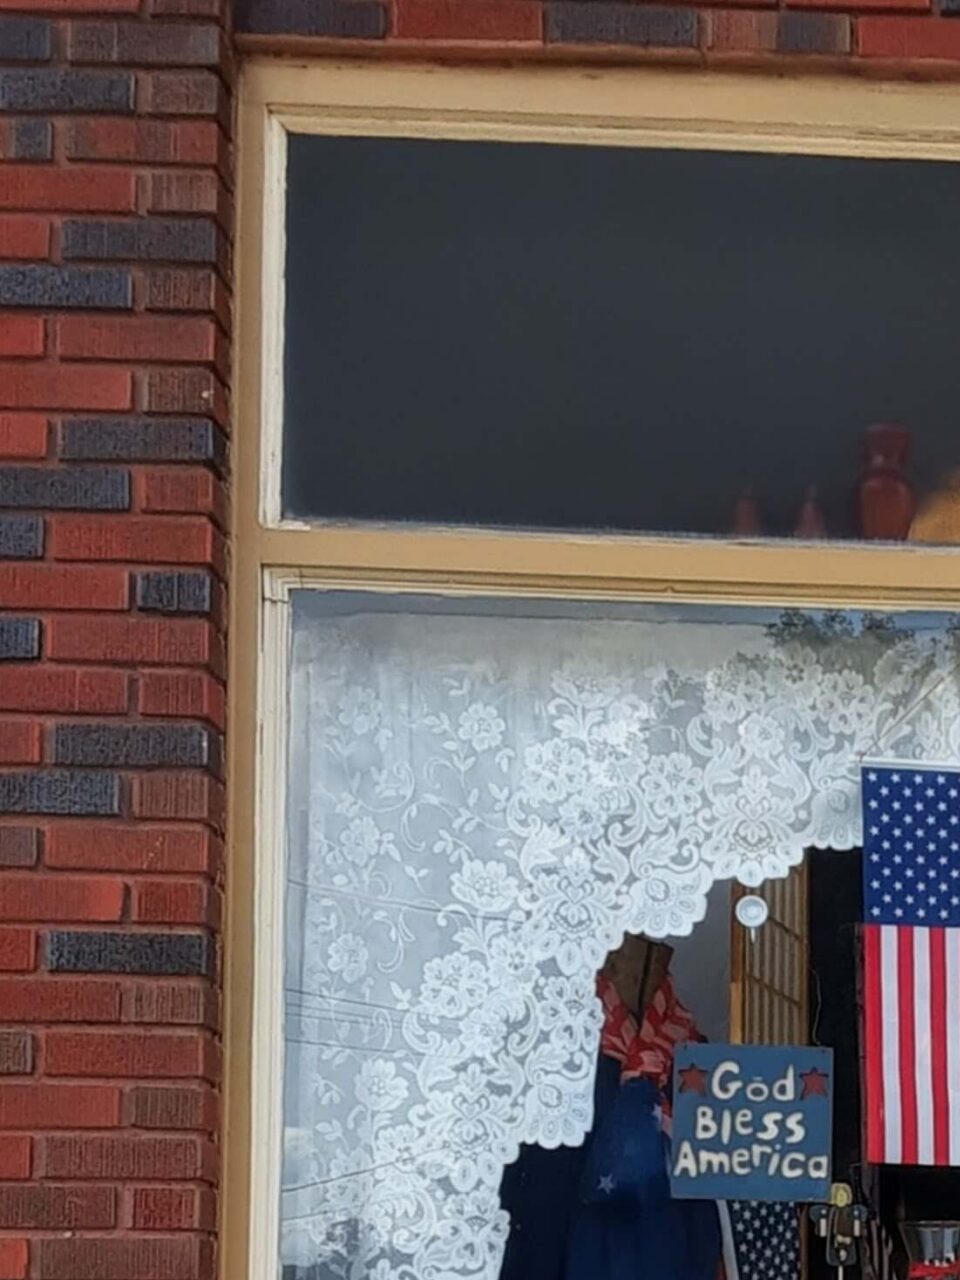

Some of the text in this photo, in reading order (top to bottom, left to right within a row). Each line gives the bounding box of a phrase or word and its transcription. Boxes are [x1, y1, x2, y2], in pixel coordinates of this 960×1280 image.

[711, 1061, 795, 1101] God
[695, 1106, 805, 1145] Bless
[673, 1140, 828, 1178] America
